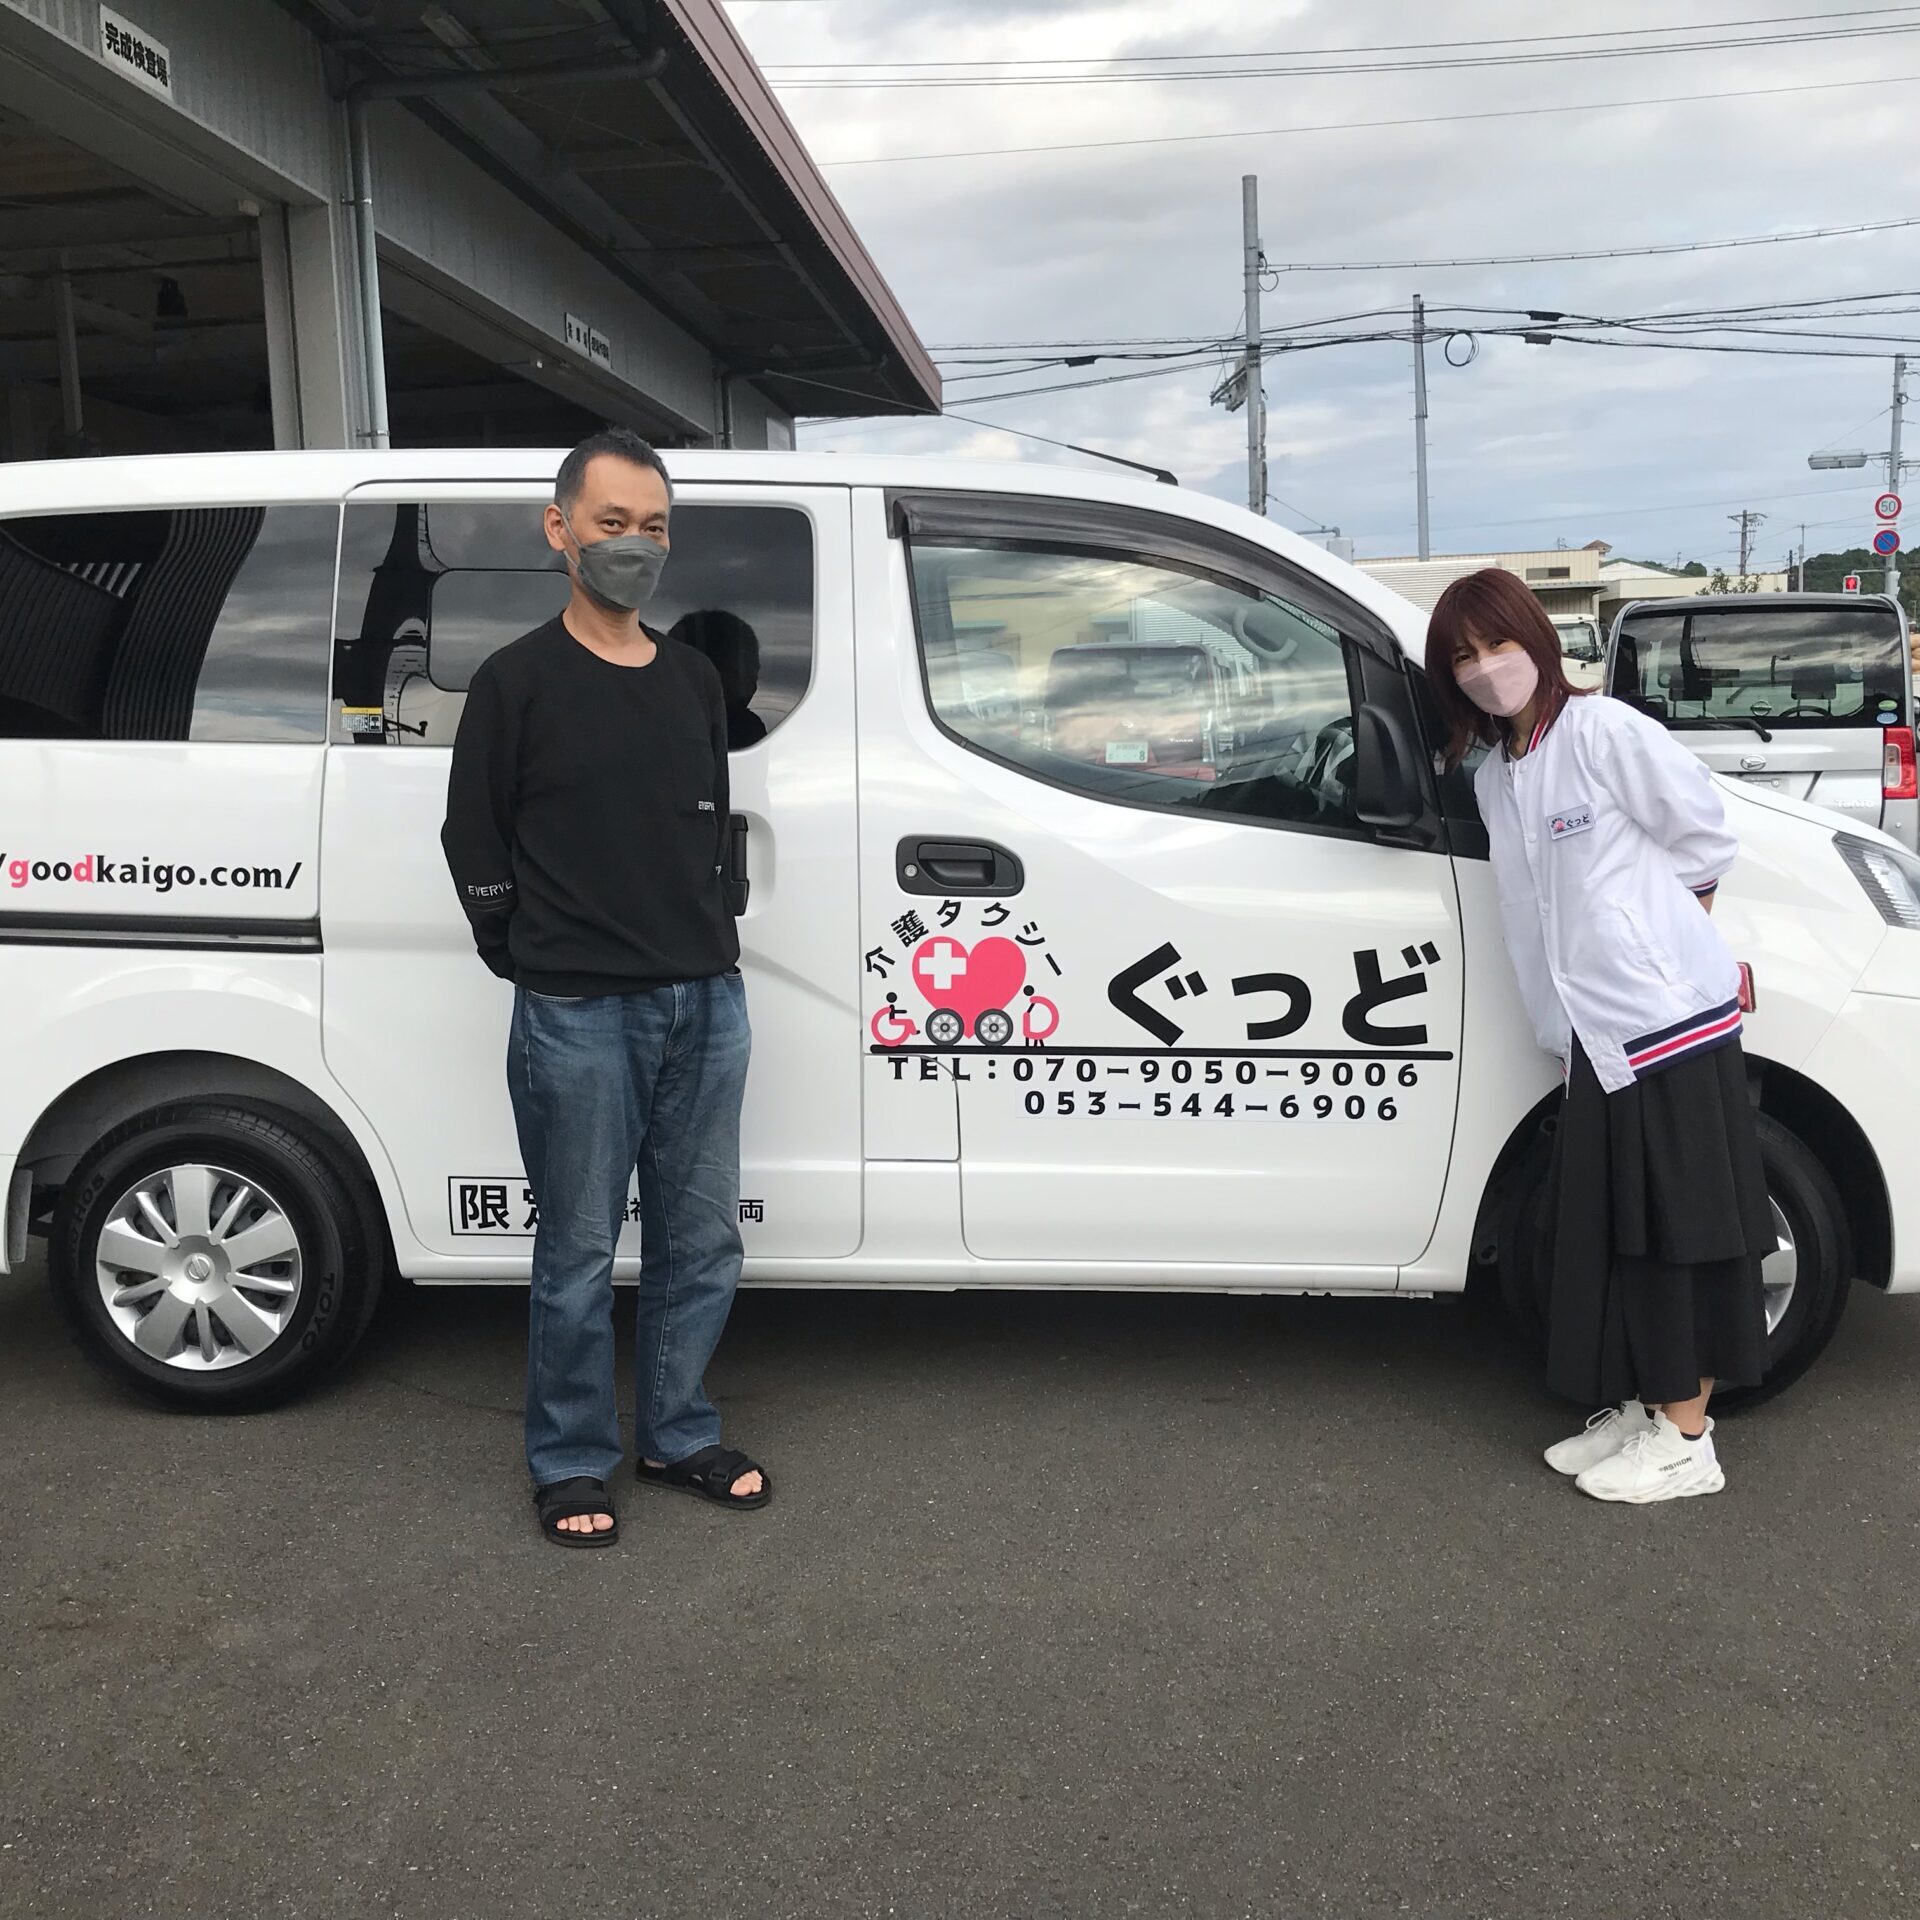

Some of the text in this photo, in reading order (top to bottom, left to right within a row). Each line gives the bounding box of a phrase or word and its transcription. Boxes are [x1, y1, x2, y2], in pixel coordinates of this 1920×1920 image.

[1881, 500, 1896, 512] 50
[865, 899, 1062, 979] 介護タクシー
[1107, 941, 1441, 1047] ぐっど
[1025, 1091, 1398, 1120] 053-544-6906
[302, 1272, 336, 1349] TOYO
